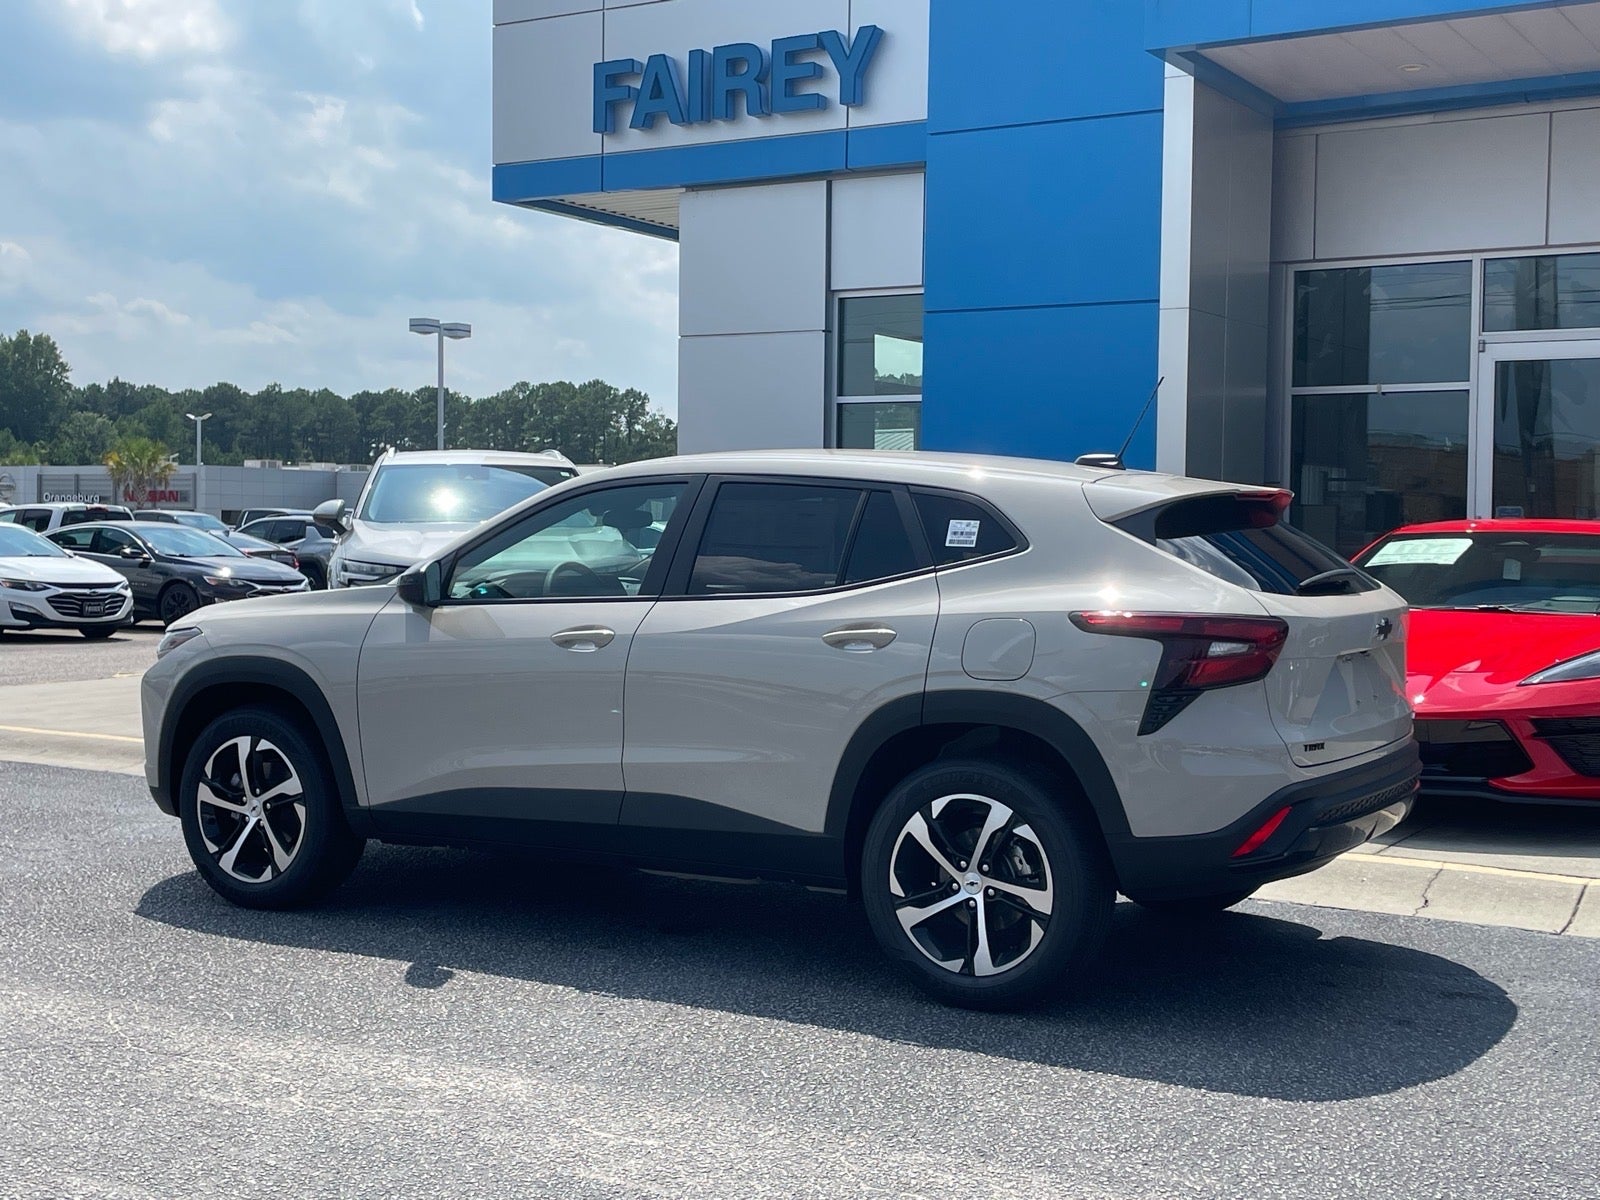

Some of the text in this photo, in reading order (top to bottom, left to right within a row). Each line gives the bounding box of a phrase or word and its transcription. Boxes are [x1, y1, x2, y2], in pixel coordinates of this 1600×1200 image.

[593, 25, 884, 133] FAIREY
[43, 492, 100, 503] Orangeburg
[124, 490, 179, 502] NSAN
